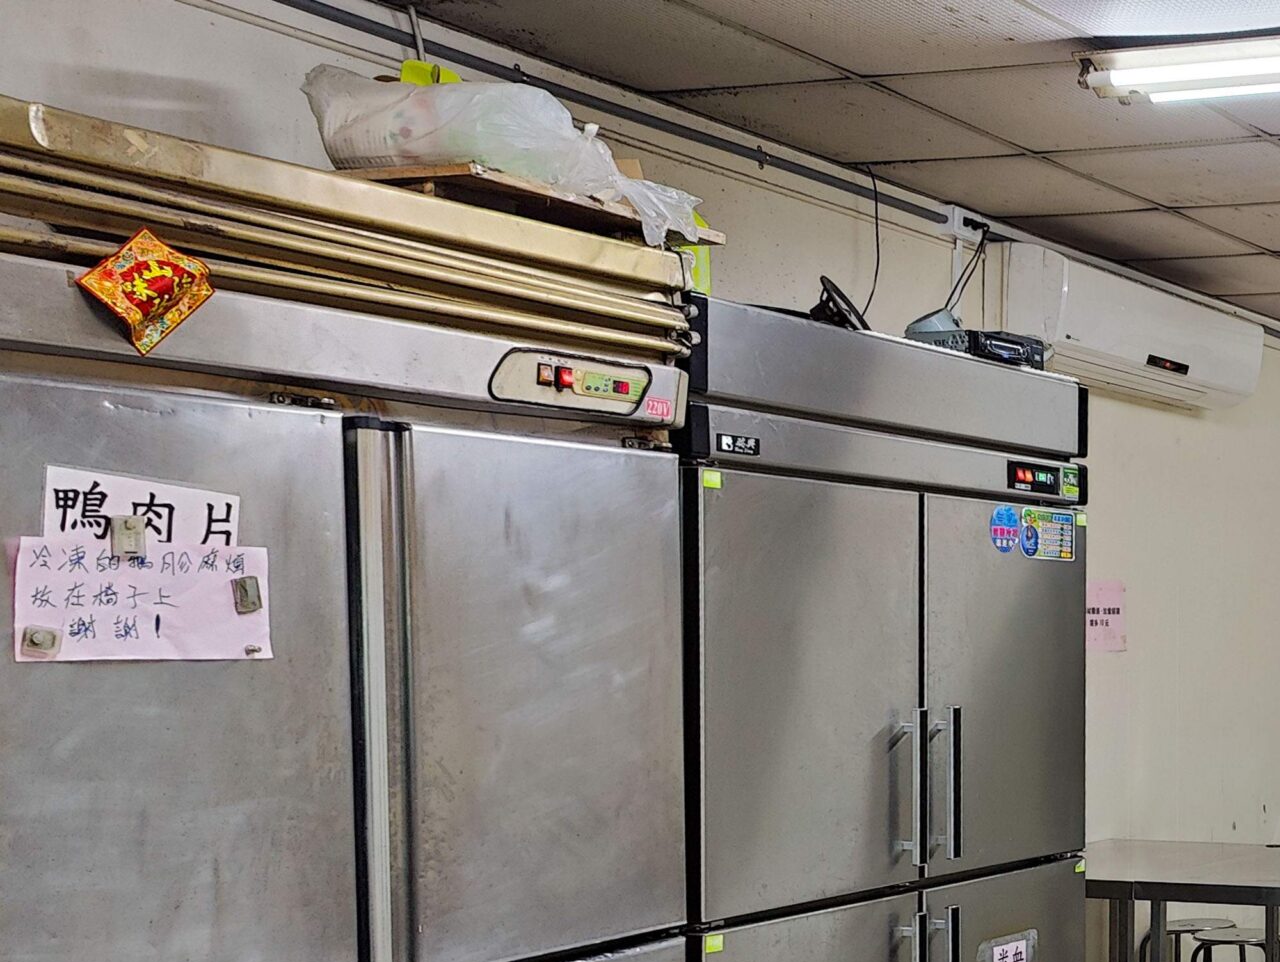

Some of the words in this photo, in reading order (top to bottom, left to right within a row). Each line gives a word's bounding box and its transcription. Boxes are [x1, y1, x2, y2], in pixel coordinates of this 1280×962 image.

[646, 401, 670, 417] 220V
[53, 481, 233, 546] 鴨肉片
